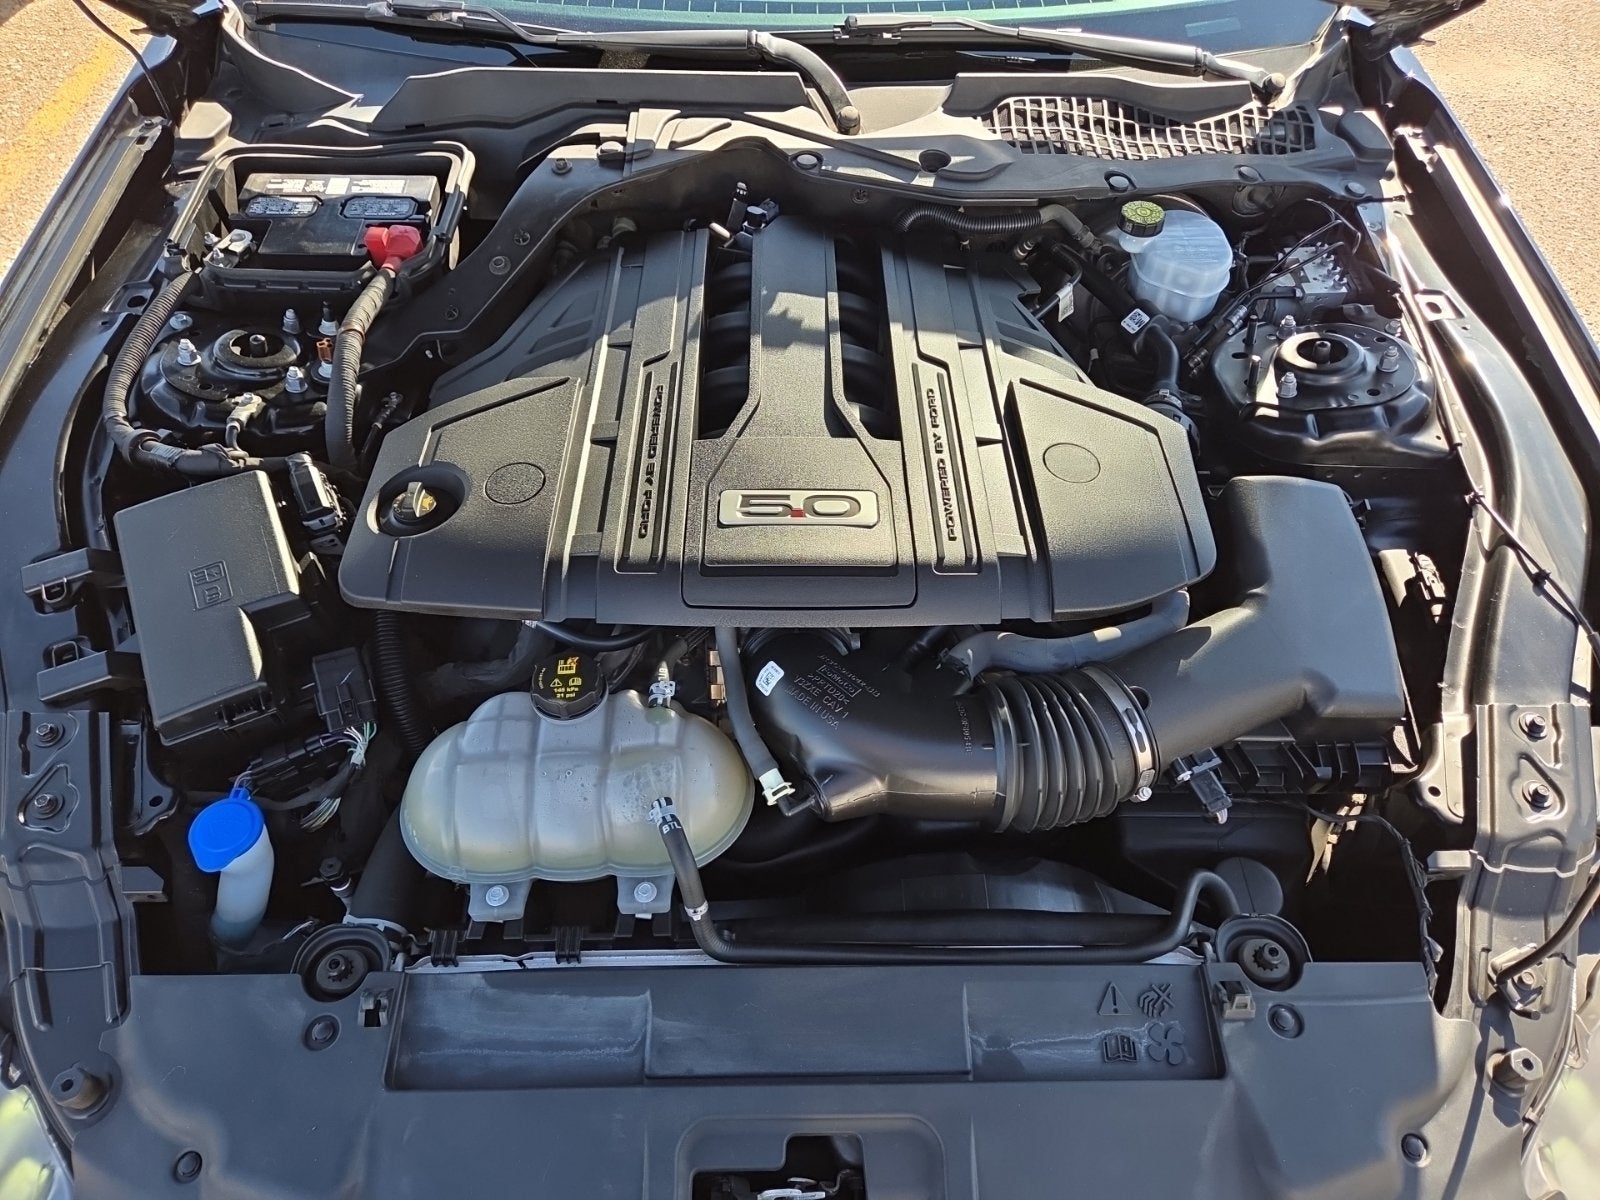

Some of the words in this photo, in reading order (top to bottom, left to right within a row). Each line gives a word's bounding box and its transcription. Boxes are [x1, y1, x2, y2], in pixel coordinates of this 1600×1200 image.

[647, 385, 664, 459] POWERED
[926, 388, 940, 428] FORD
[933, 432, 944, 454] BY
[644, 462, 656, 487] BY
[736, 494, 862, 518] 5.0
[936, 457, 957, 542] POWERED
[638, 489, 654, 539] FORD
[820, 667, 856, 693] FoMoCo
[809, 701, 823, 713] IN
[820, 709, 840, 731] USA
[662, 821, 682, 834] BTL
